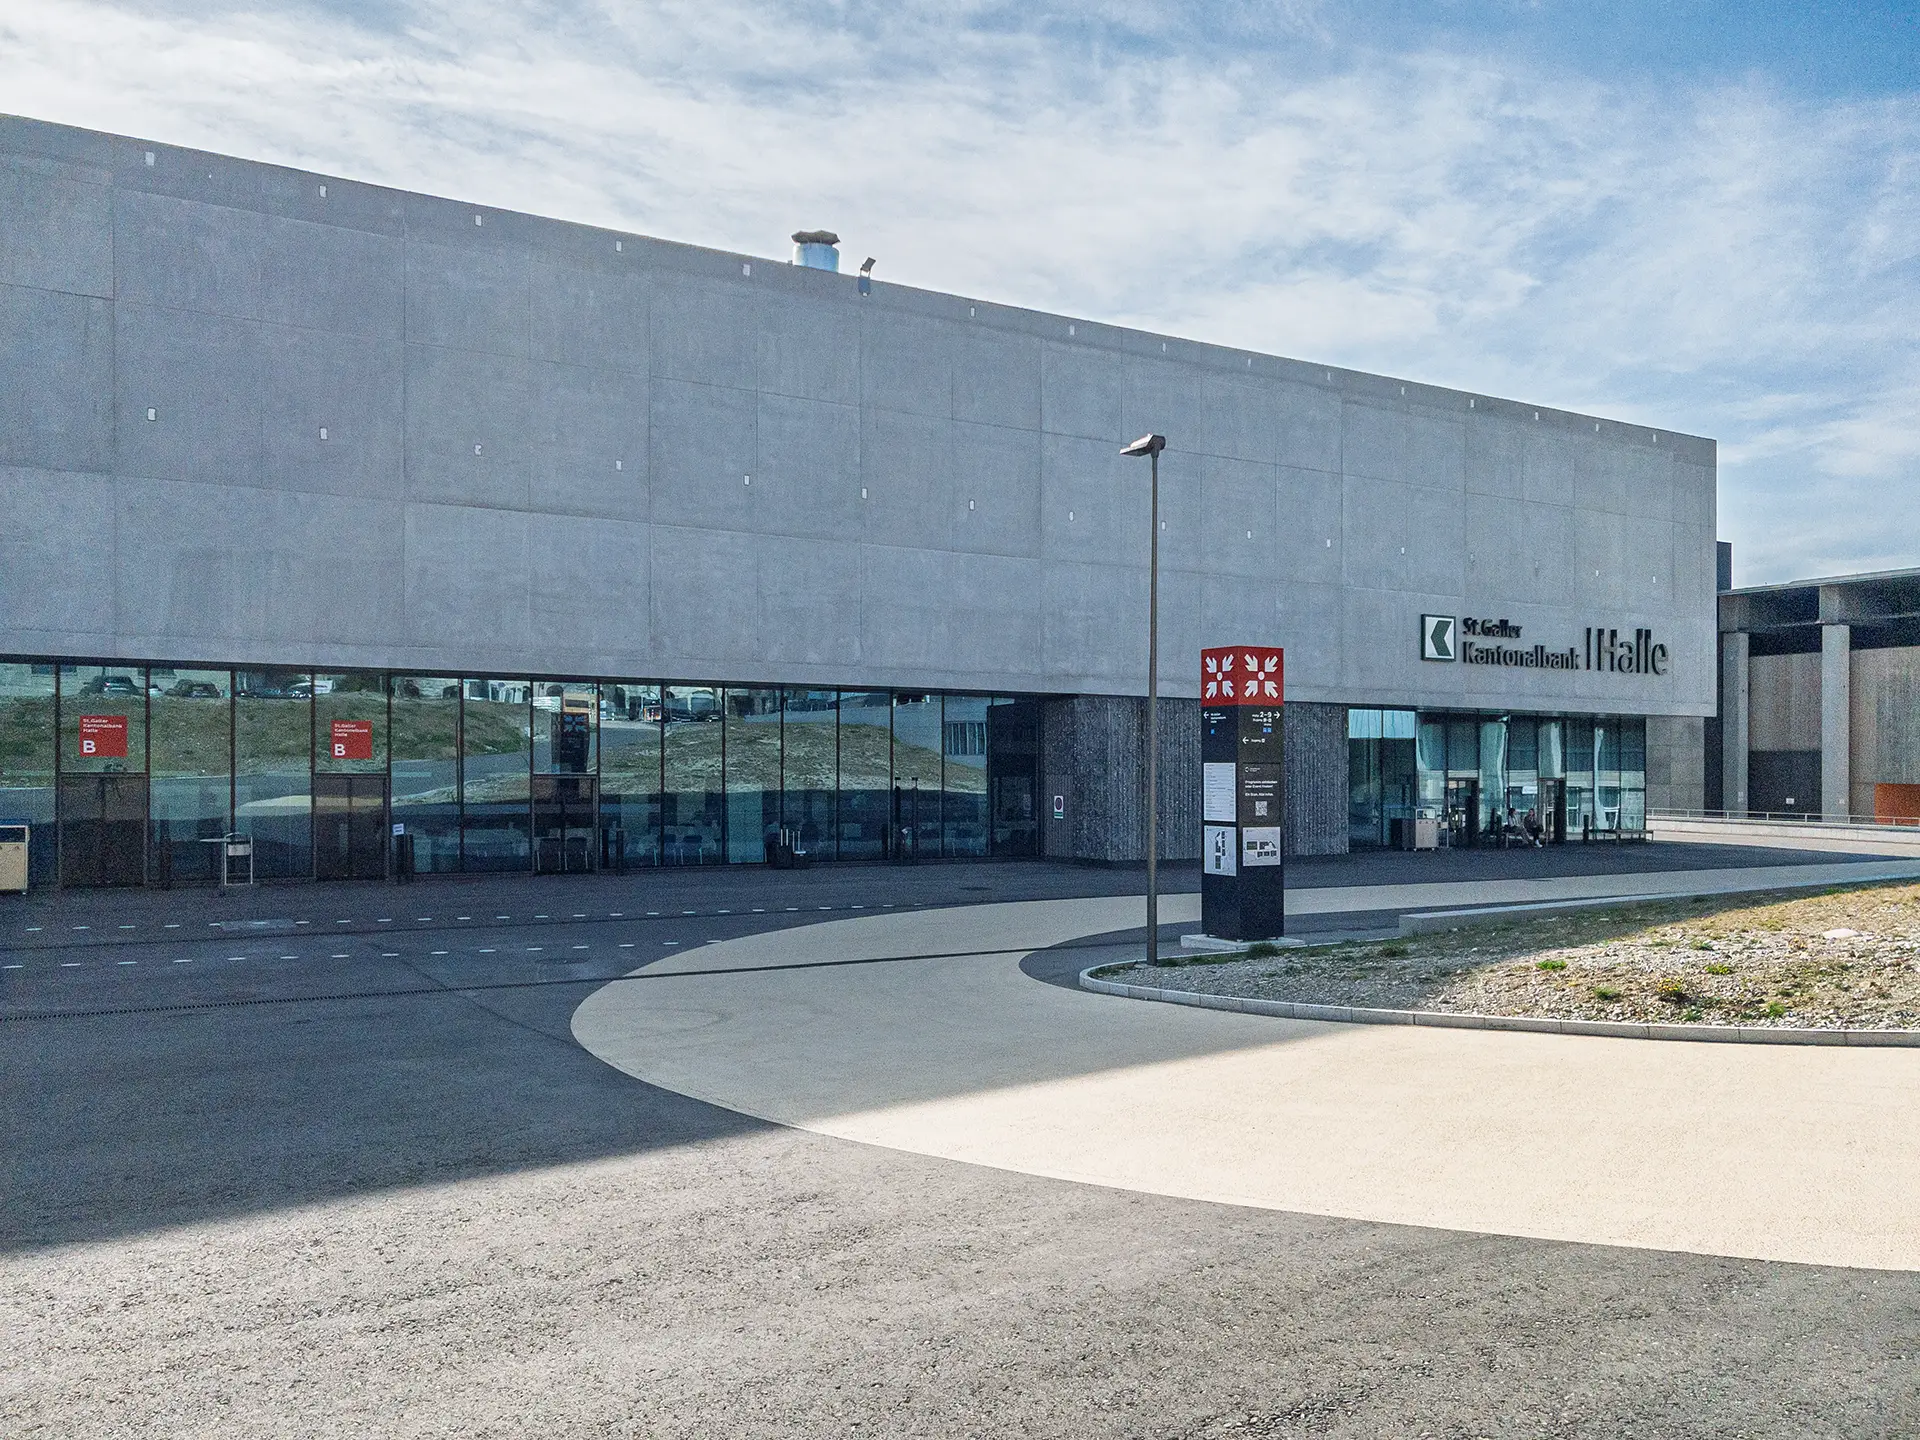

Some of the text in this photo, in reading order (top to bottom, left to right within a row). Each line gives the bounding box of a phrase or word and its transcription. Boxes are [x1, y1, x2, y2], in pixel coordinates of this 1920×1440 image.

[1462, 641, 1579, 669] Kantonalbank
[1597, 628, 1669, 675] Halle
[83, 740, 96, 753] B
[334, 743, 346, 756] B
